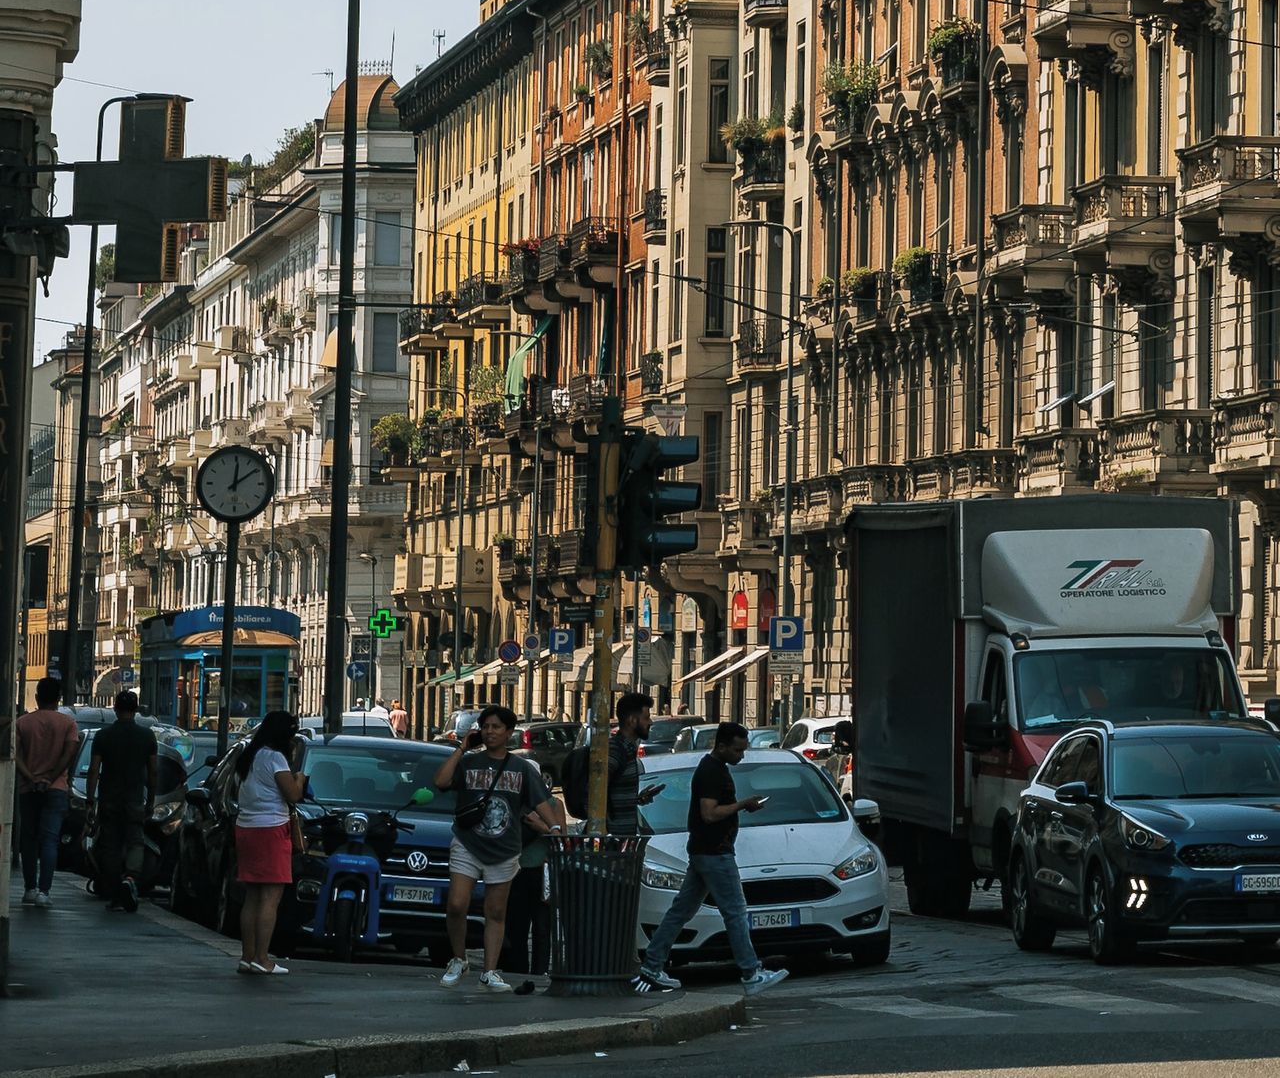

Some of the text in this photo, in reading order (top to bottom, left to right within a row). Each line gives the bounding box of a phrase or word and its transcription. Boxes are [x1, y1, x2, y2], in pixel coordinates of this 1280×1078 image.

[1060, 588, 1167, 598] OPERATORE LOGISTICO
[554, 631, 569, 651] P
[776, 620, 797, 648] P
